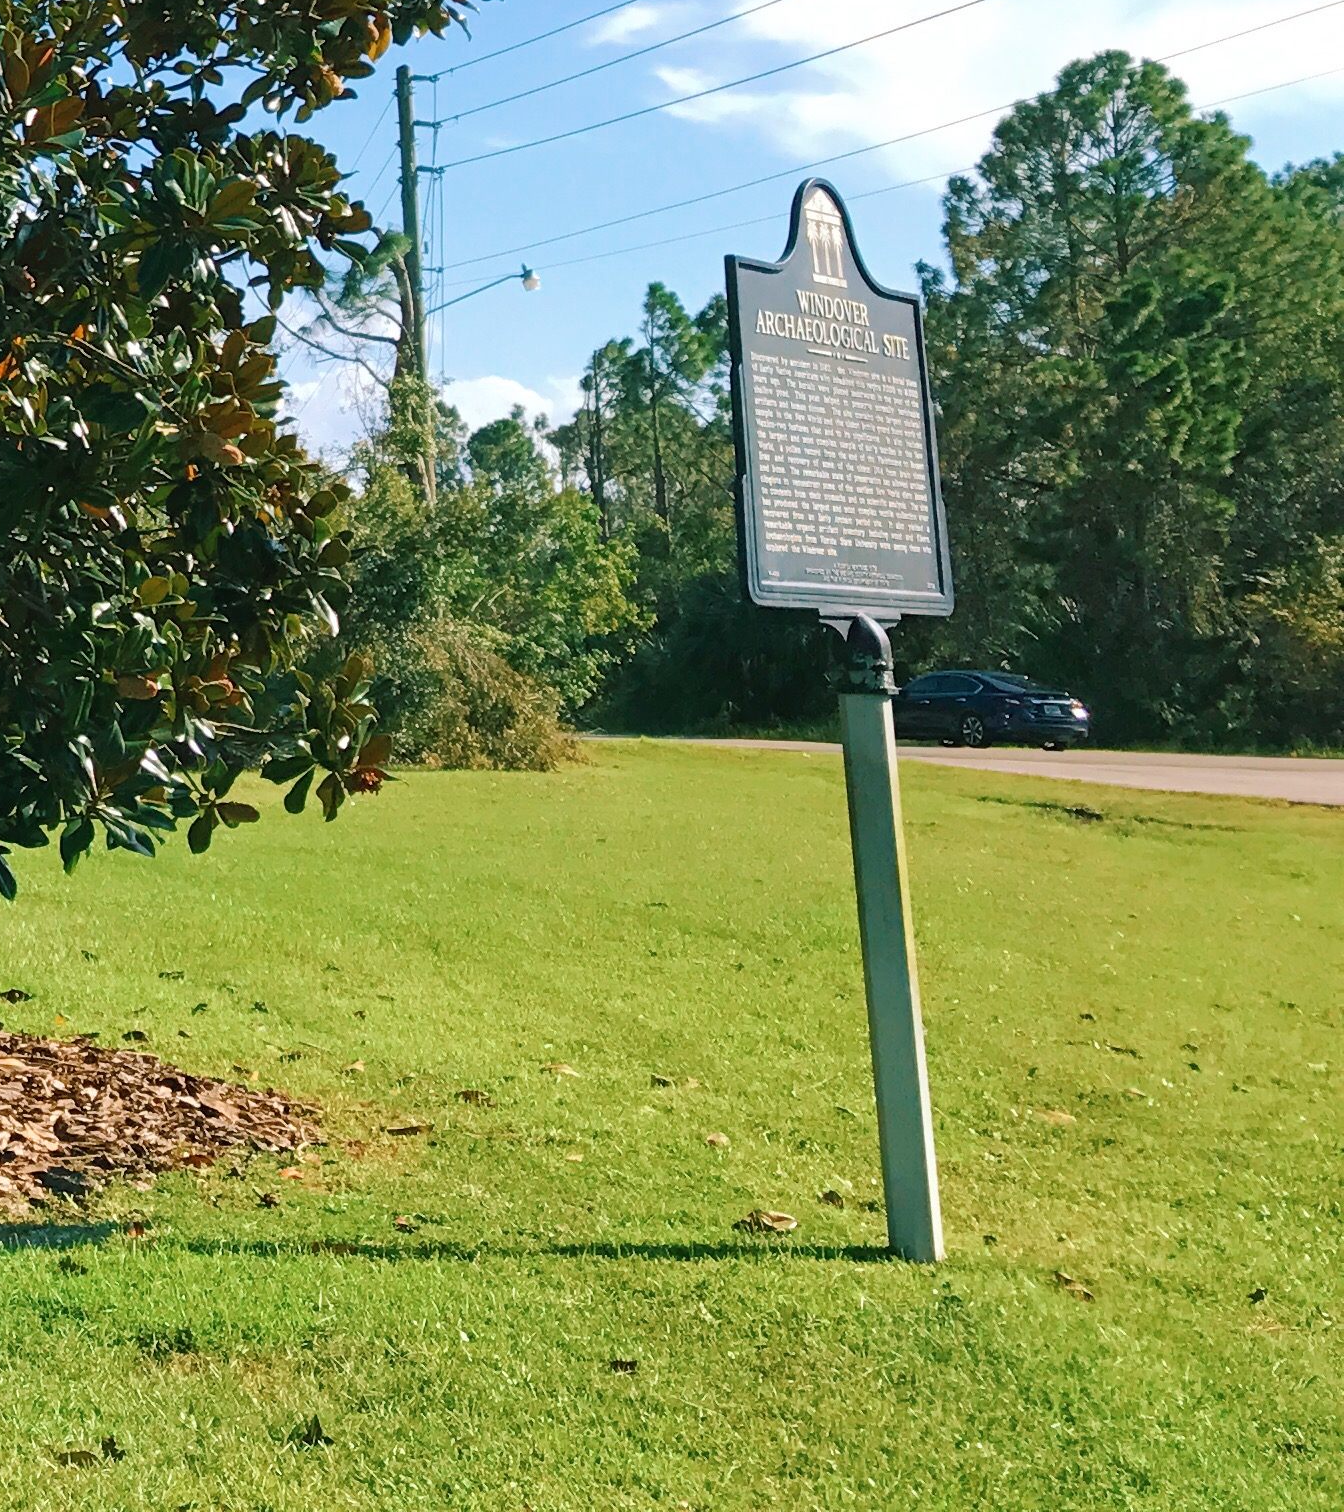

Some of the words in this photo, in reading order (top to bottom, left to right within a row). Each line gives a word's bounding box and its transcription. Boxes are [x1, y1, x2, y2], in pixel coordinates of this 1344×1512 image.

[796, 289, 870, 327] WINDOVER
[755, 309, 880, 355] ARCHAEOLOGICAL
[882, 334, 911, 361] SITE
